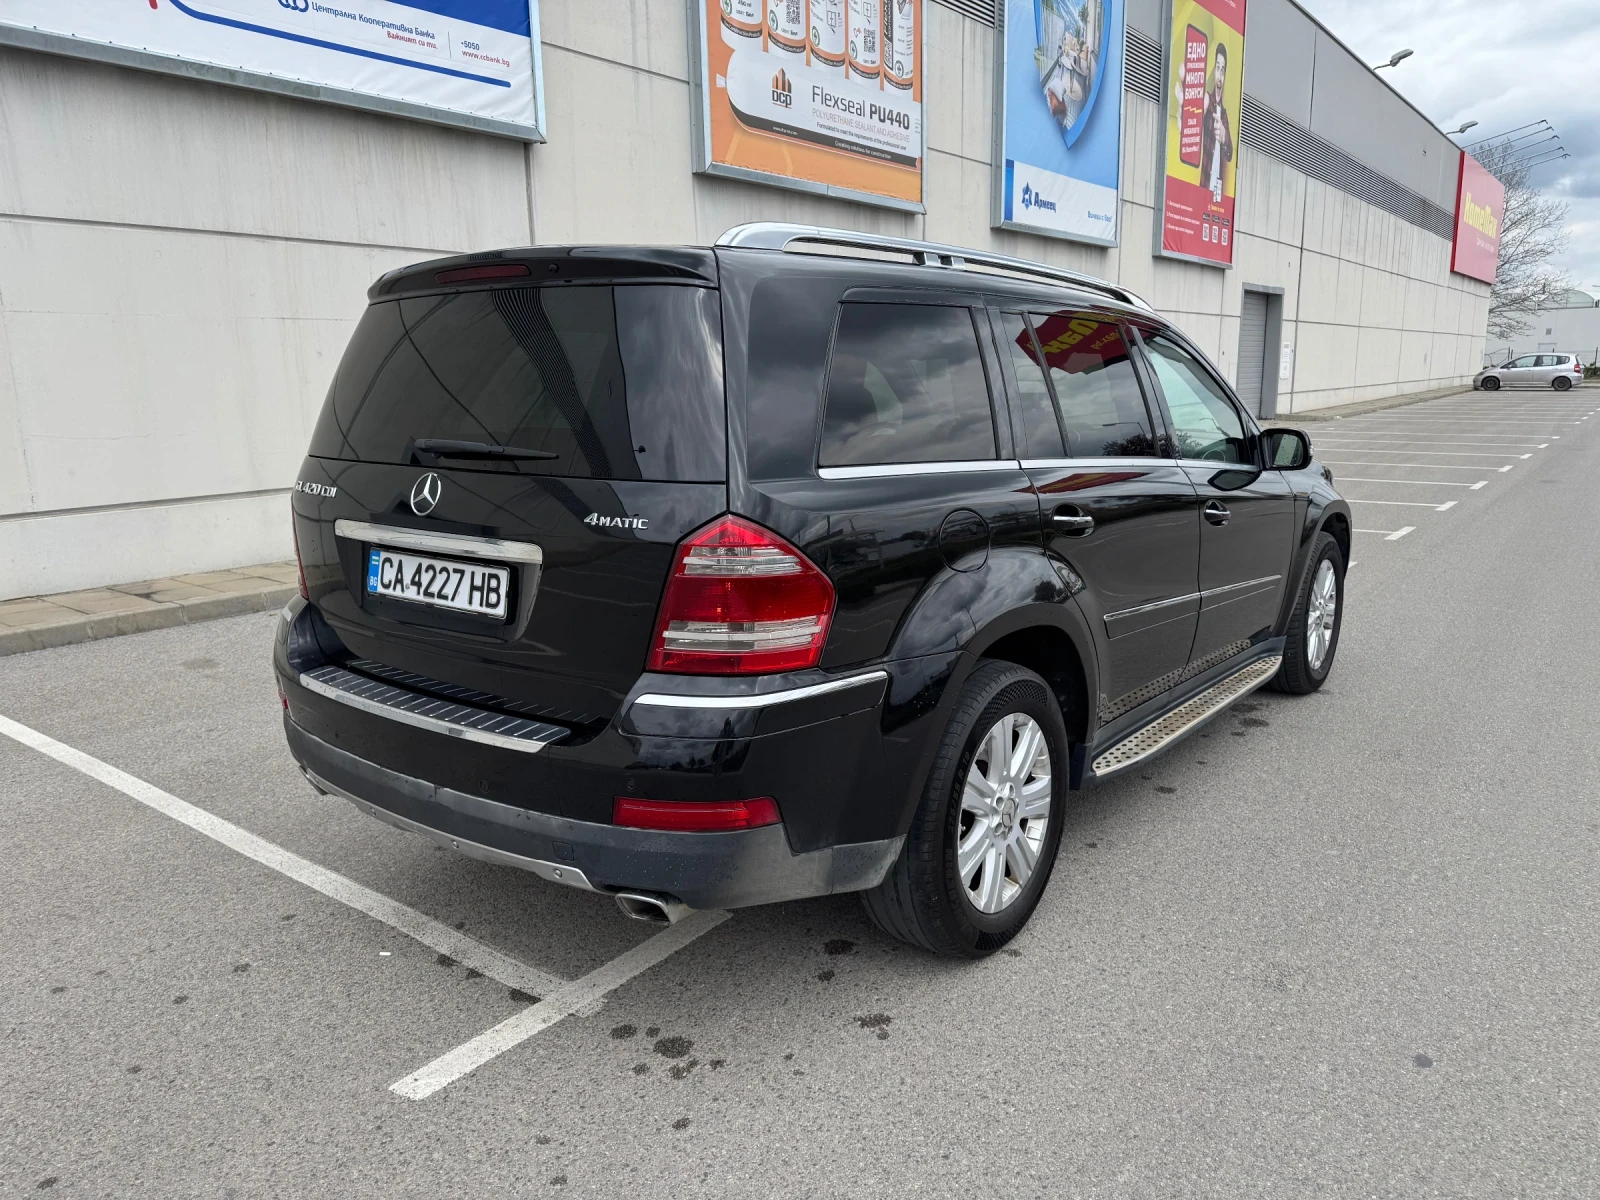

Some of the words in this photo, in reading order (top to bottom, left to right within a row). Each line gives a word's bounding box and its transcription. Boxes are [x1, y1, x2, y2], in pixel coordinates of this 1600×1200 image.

[312, 1, 356, 20] Централна
[358, 13, 413, 34] Кооперативна
[415, 27, 435, 39] Банка
[462, 50, 510, 67] www.ccbank.bg
[1187, 42, 1206, 61] ЕДНО
[1186, 72, 1204, 84] МНОГО
[1185, 87, 1203, 99] БОНУСИ
[812, 85, 865, 117] Flexseal
[869, 103, 910, 130] PU440
[812, 108, 854, 128] POLYURETHANE
[855, 119, 876, 134] SEALANT
[1034, 192, 1056, 213] Армеец
[584, 512, 649, 529] 4MATIC
[369, 575, 378, 586] BG
[380, 557, 405, 594] CA
[410, 562, 465, 602] 4227
[468, 571, 501, 610] HB
